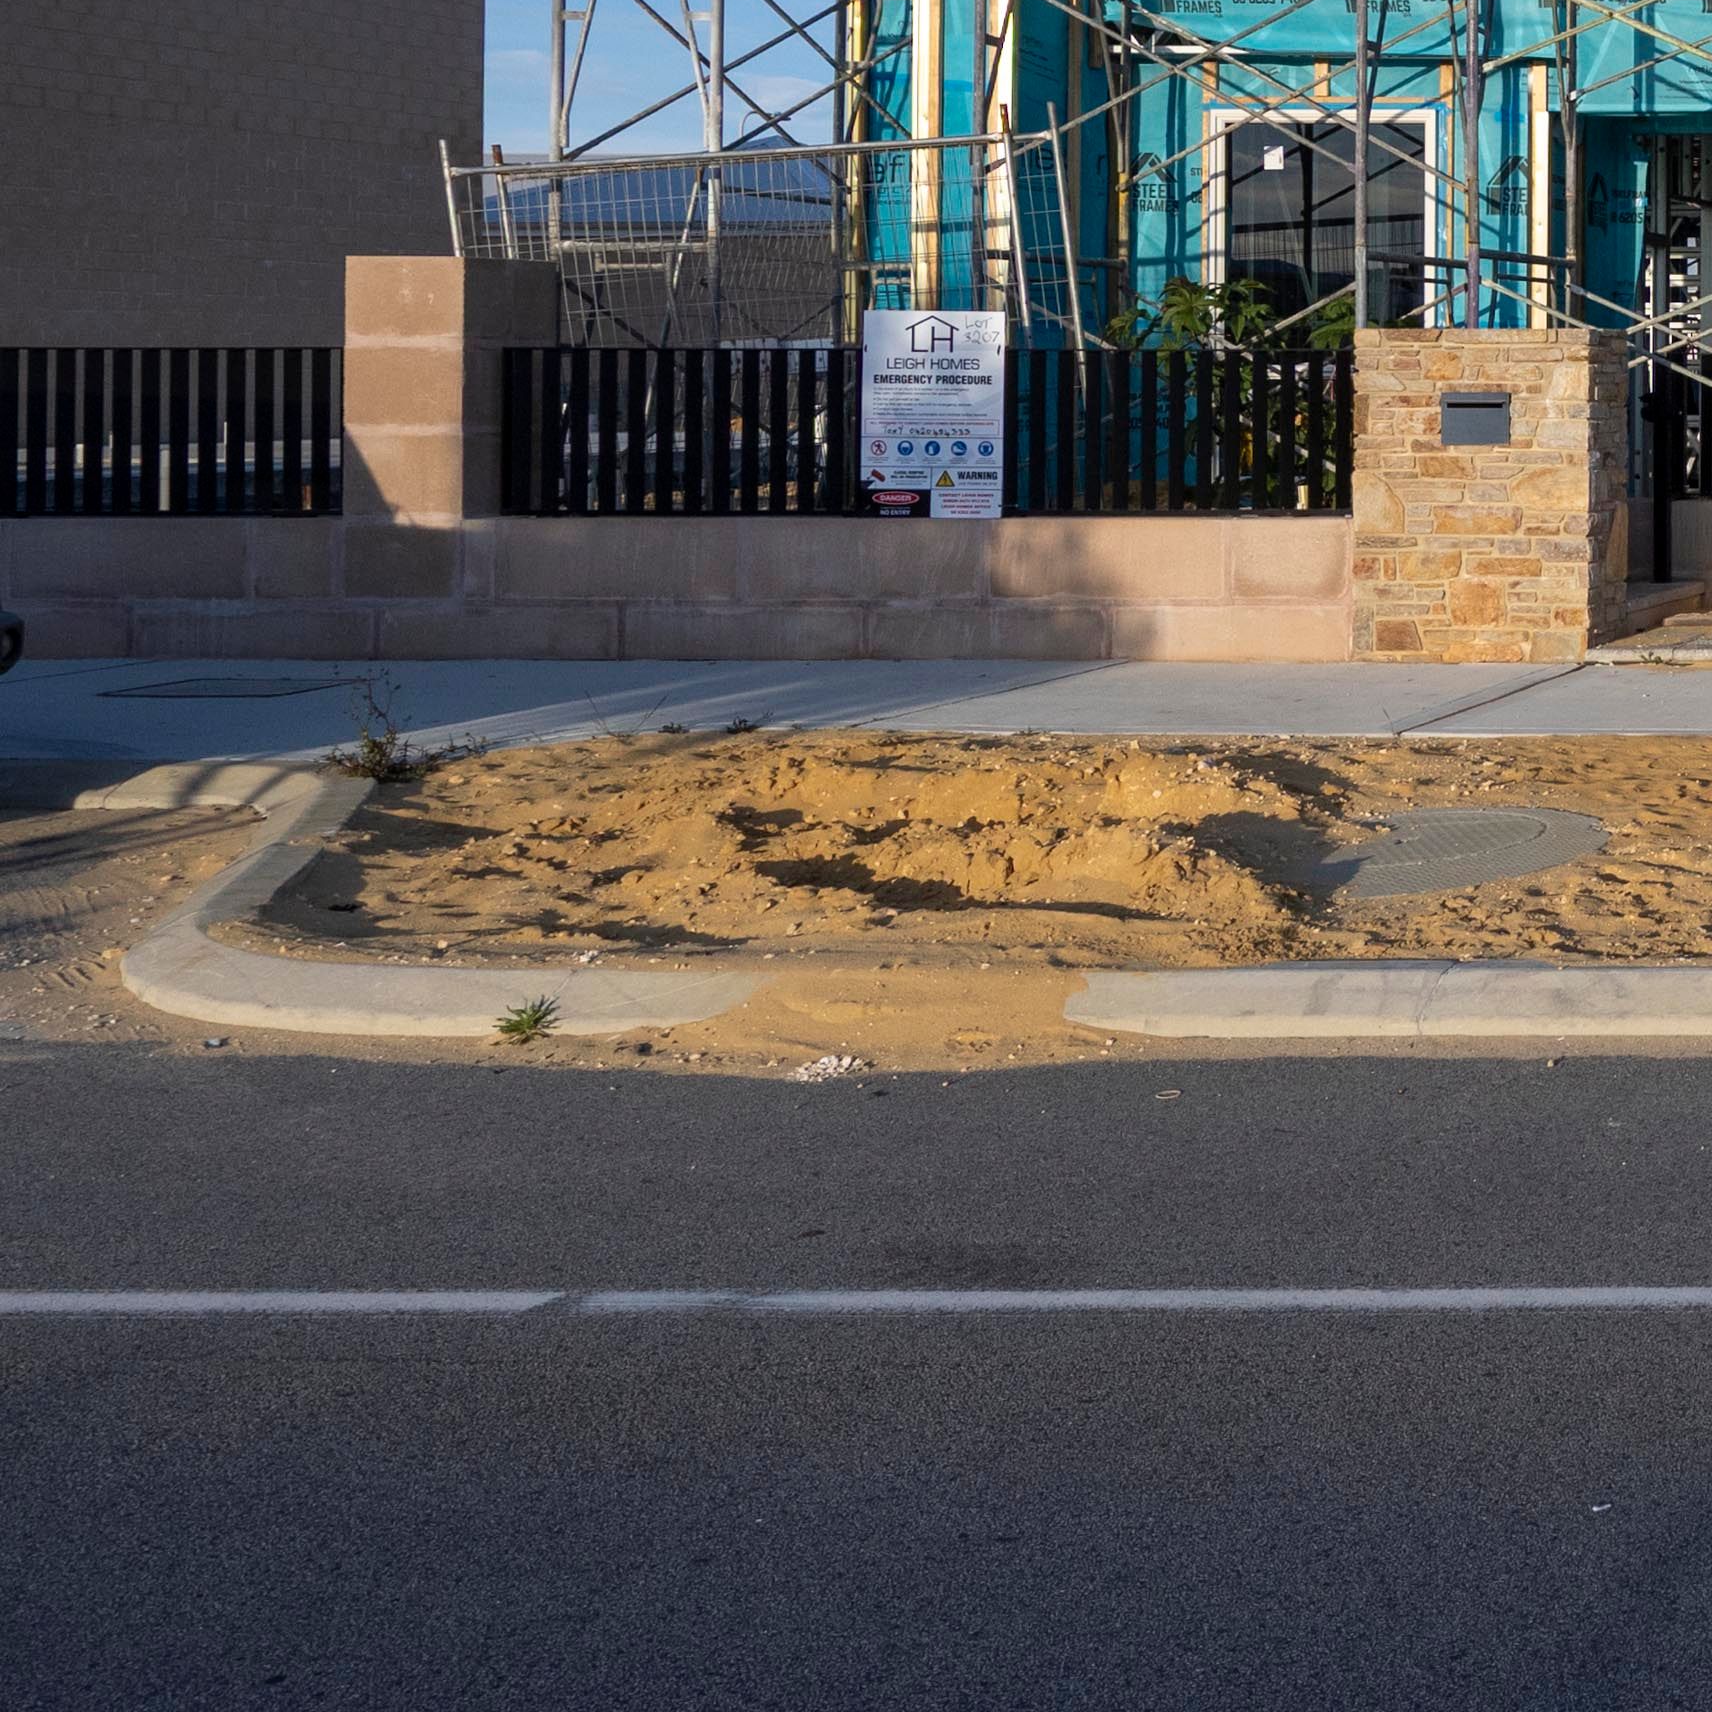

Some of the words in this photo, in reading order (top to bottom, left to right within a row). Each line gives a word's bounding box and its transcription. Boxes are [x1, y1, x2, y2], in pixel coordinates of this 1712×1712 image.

[1176, 1, 1222, 14] FRAMES
[1366, 0, 1411, 13] FRMES
[886, 357, 926, 370] LEIGH
[930, 357, 981, 370] HOMES
[873, 374, 932, 385] EMERGENCY
[935, 374, 993, 385] PROCEDURE
[957, 471, 998, 481] WARNING
[880, 494, 912, 502] DANGER
